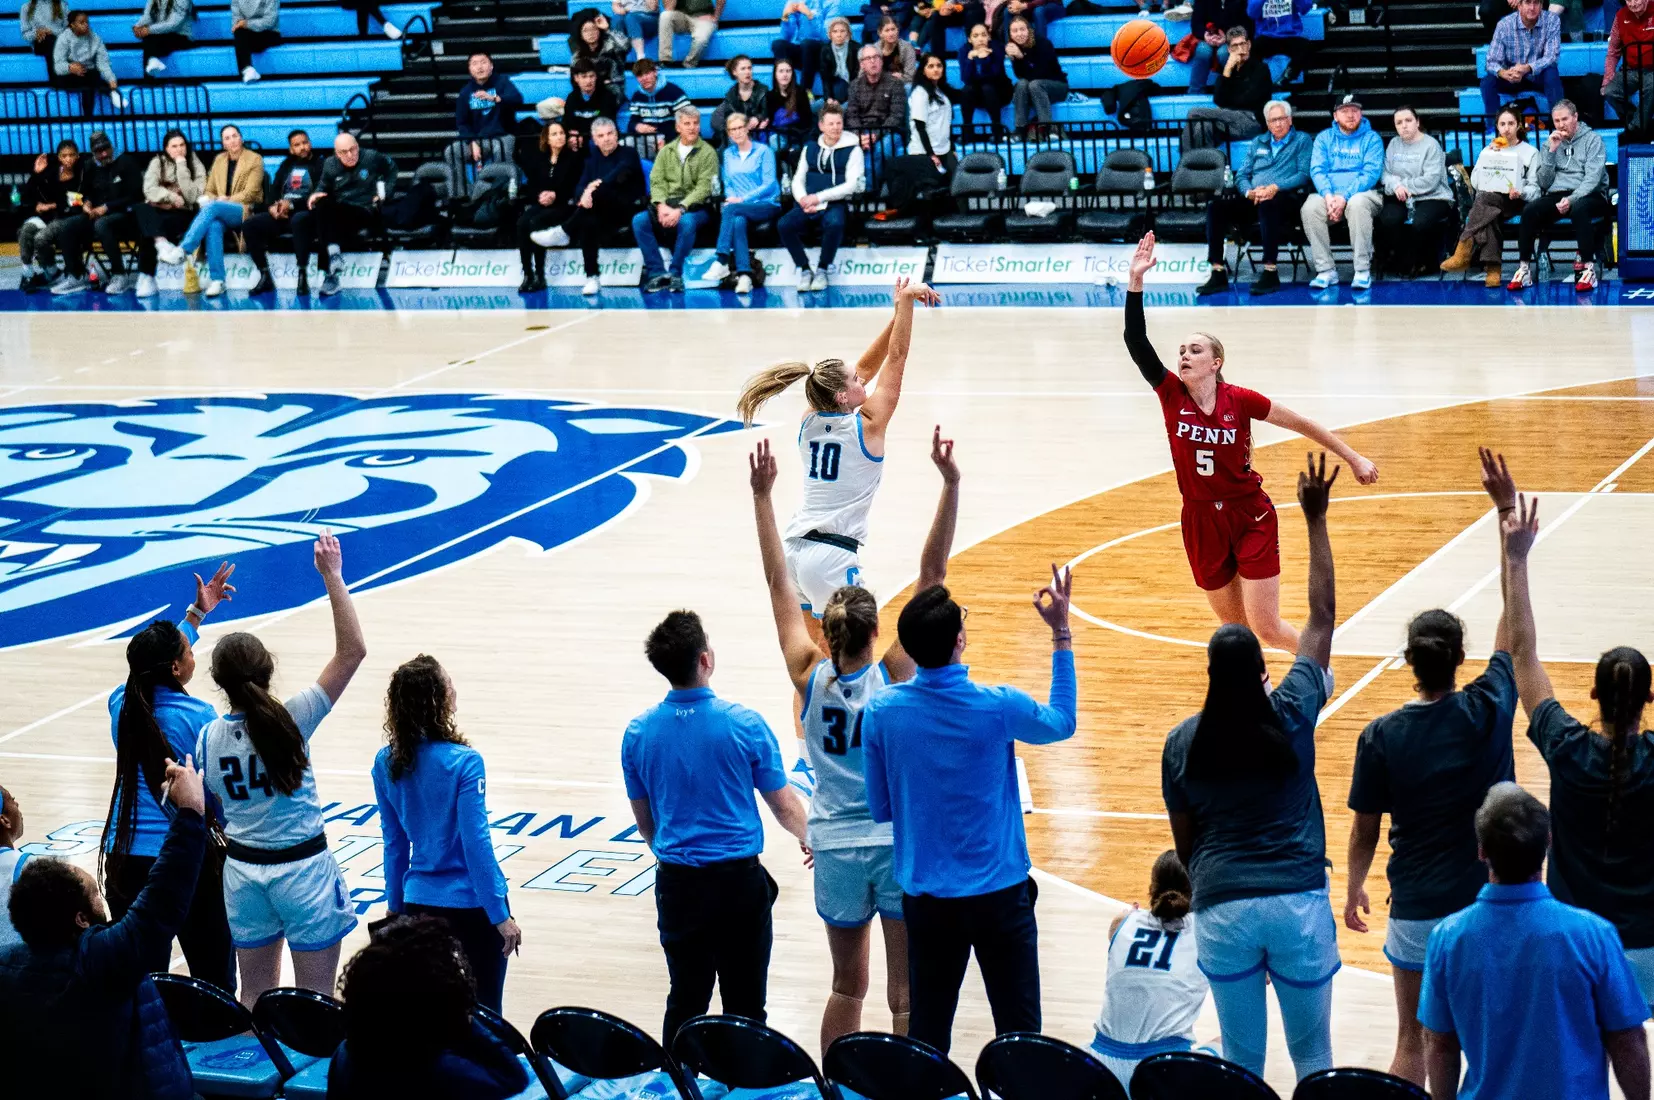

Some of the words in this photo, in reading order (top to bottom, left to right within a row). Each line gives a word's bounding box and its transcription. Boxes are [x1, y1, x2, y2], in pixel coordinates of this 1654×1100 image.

[394, 259, 510, 276] TicketSmarter
[942, 256, 1072, 273] TicketSmarter
[1083, 256, 1209, 273] Tickemarte
[1175, 421, 1237, 445] PENN
[809, 441, 841, 481] 10
[1195, 449, 1214, 477] 5
[219, 754, 274, 801] 24
[1125, 927, 1180, 971] 21
